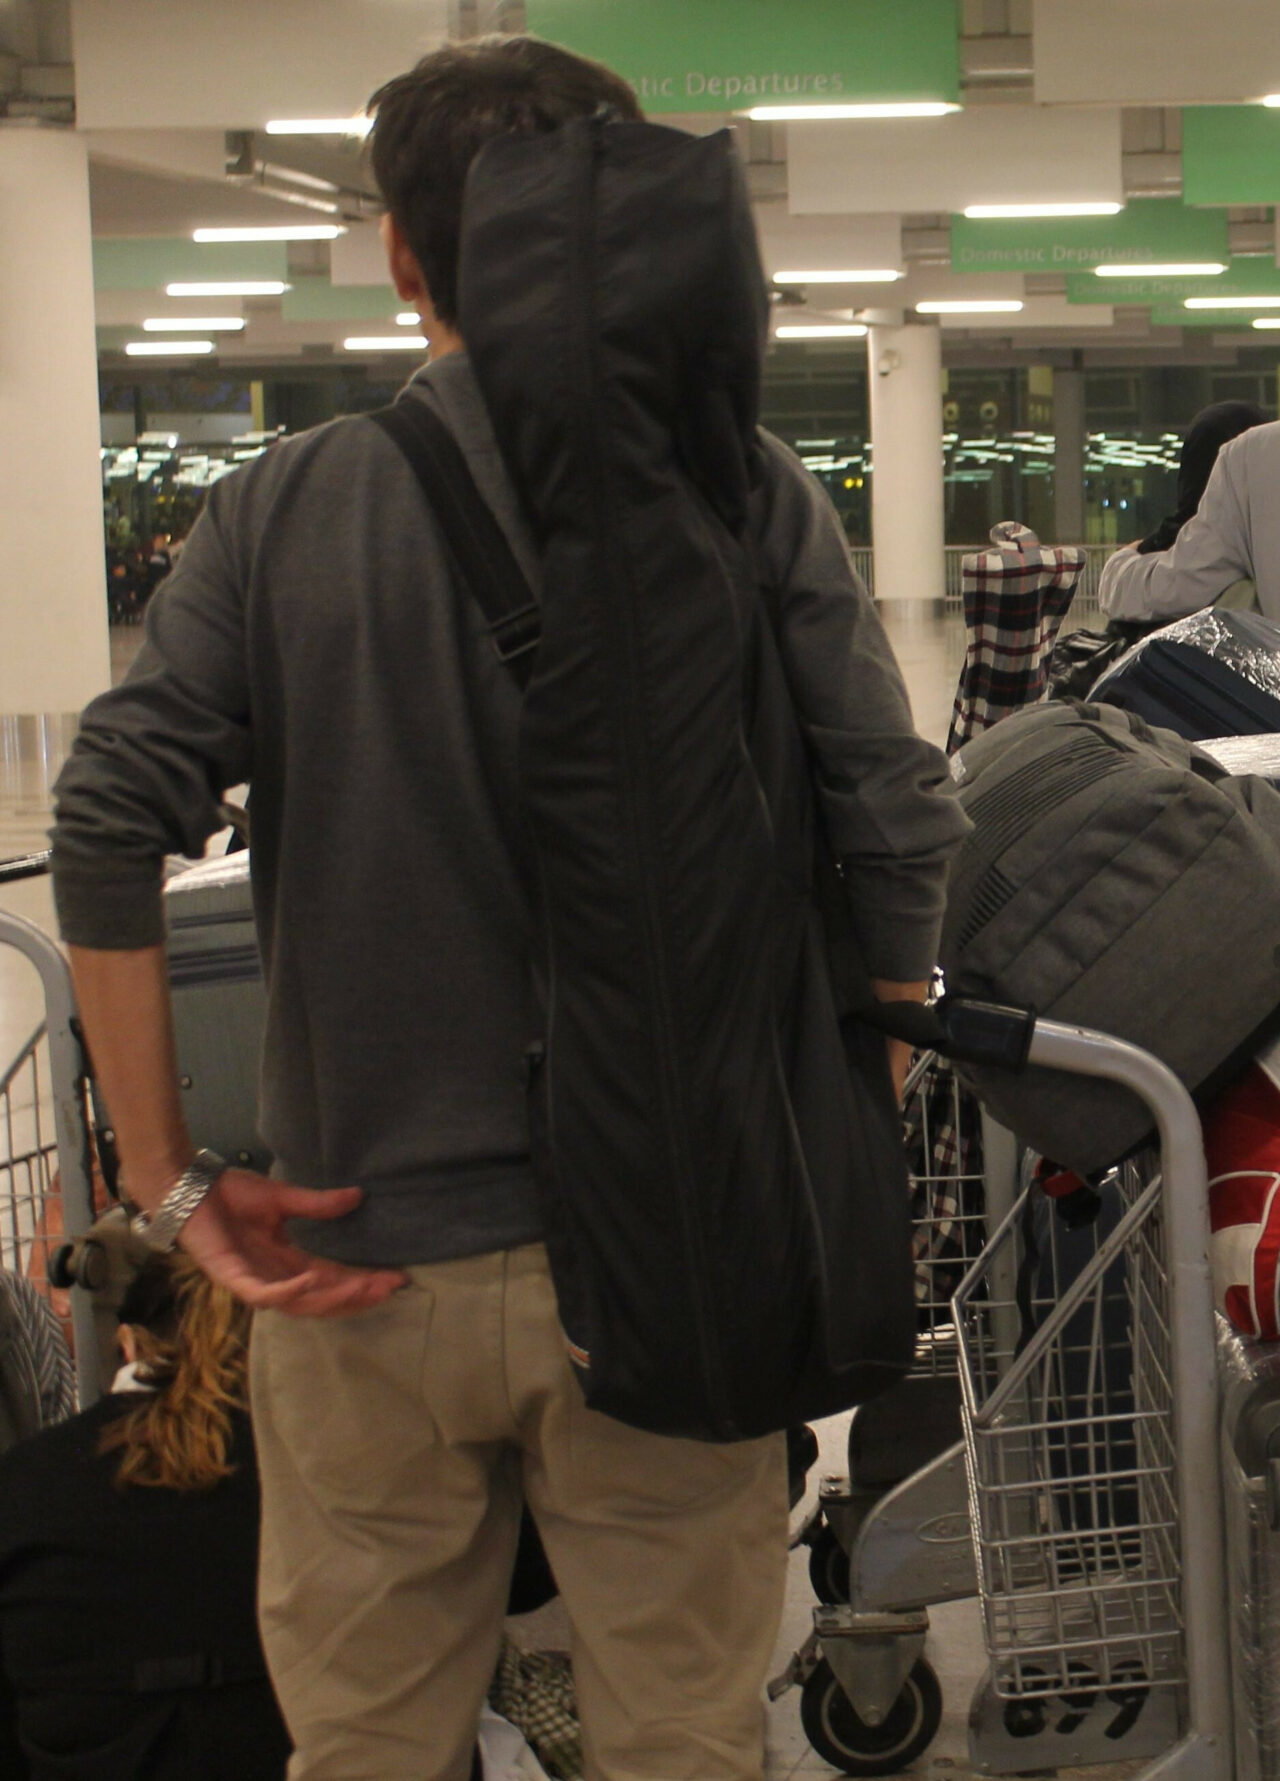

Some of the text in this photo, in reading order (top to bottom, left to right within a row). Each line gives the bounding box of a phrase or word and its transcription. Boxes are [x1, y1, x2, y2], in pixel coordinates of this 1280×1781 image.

[686, 72, 843, 100] Departures
[960, 244, 1152, 263] Domestic Departures
